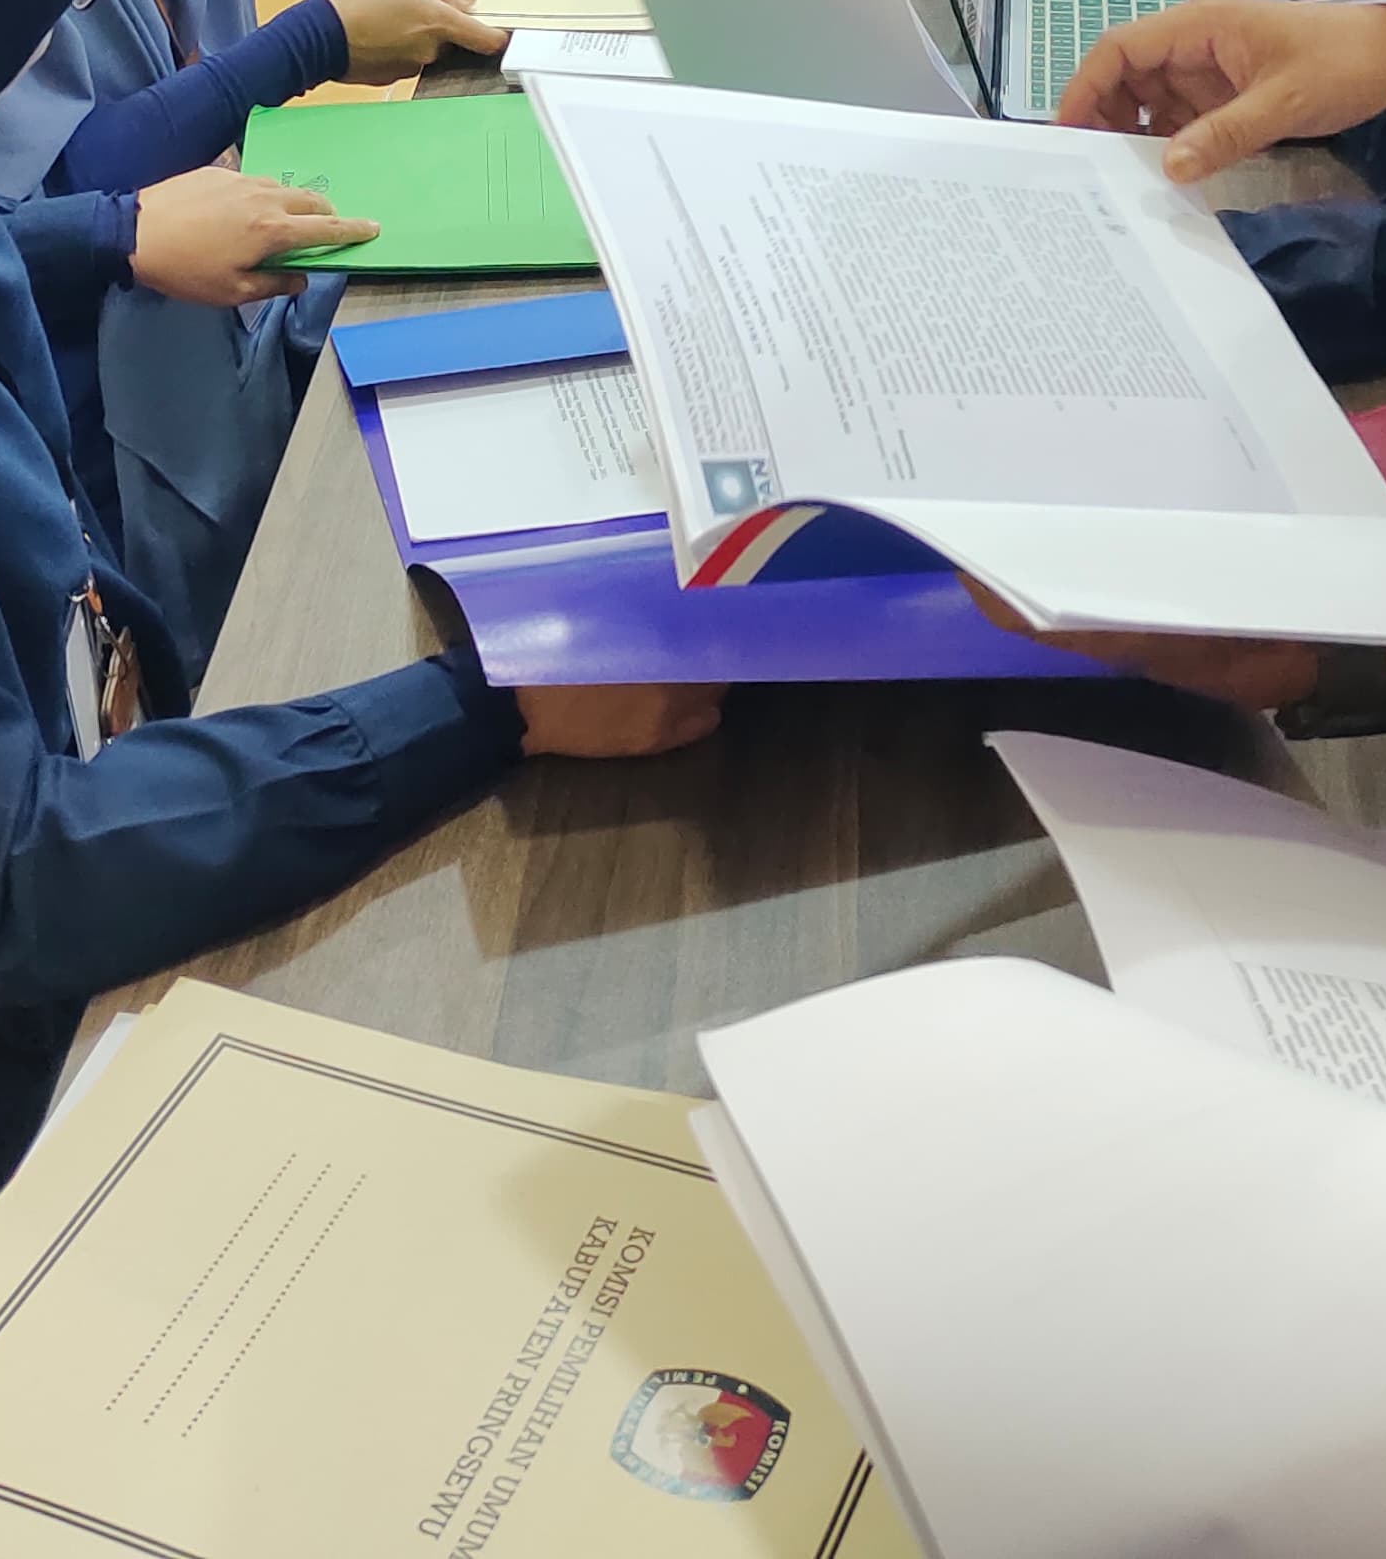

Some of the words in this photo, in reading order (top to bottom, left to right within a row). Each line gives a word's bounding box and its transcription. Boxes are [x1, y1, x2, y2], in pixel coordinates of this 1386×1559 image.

[516, 1215, 619, 1373] KABUPATEN
[589, 1226, 657, 1319] KOMISI
[418, 1371, 532, 1541] PRINGSEWU
[505, 1319, 606, 1472] PEMILIHAN
[744, 1419, 788, 1492] KOMISI
